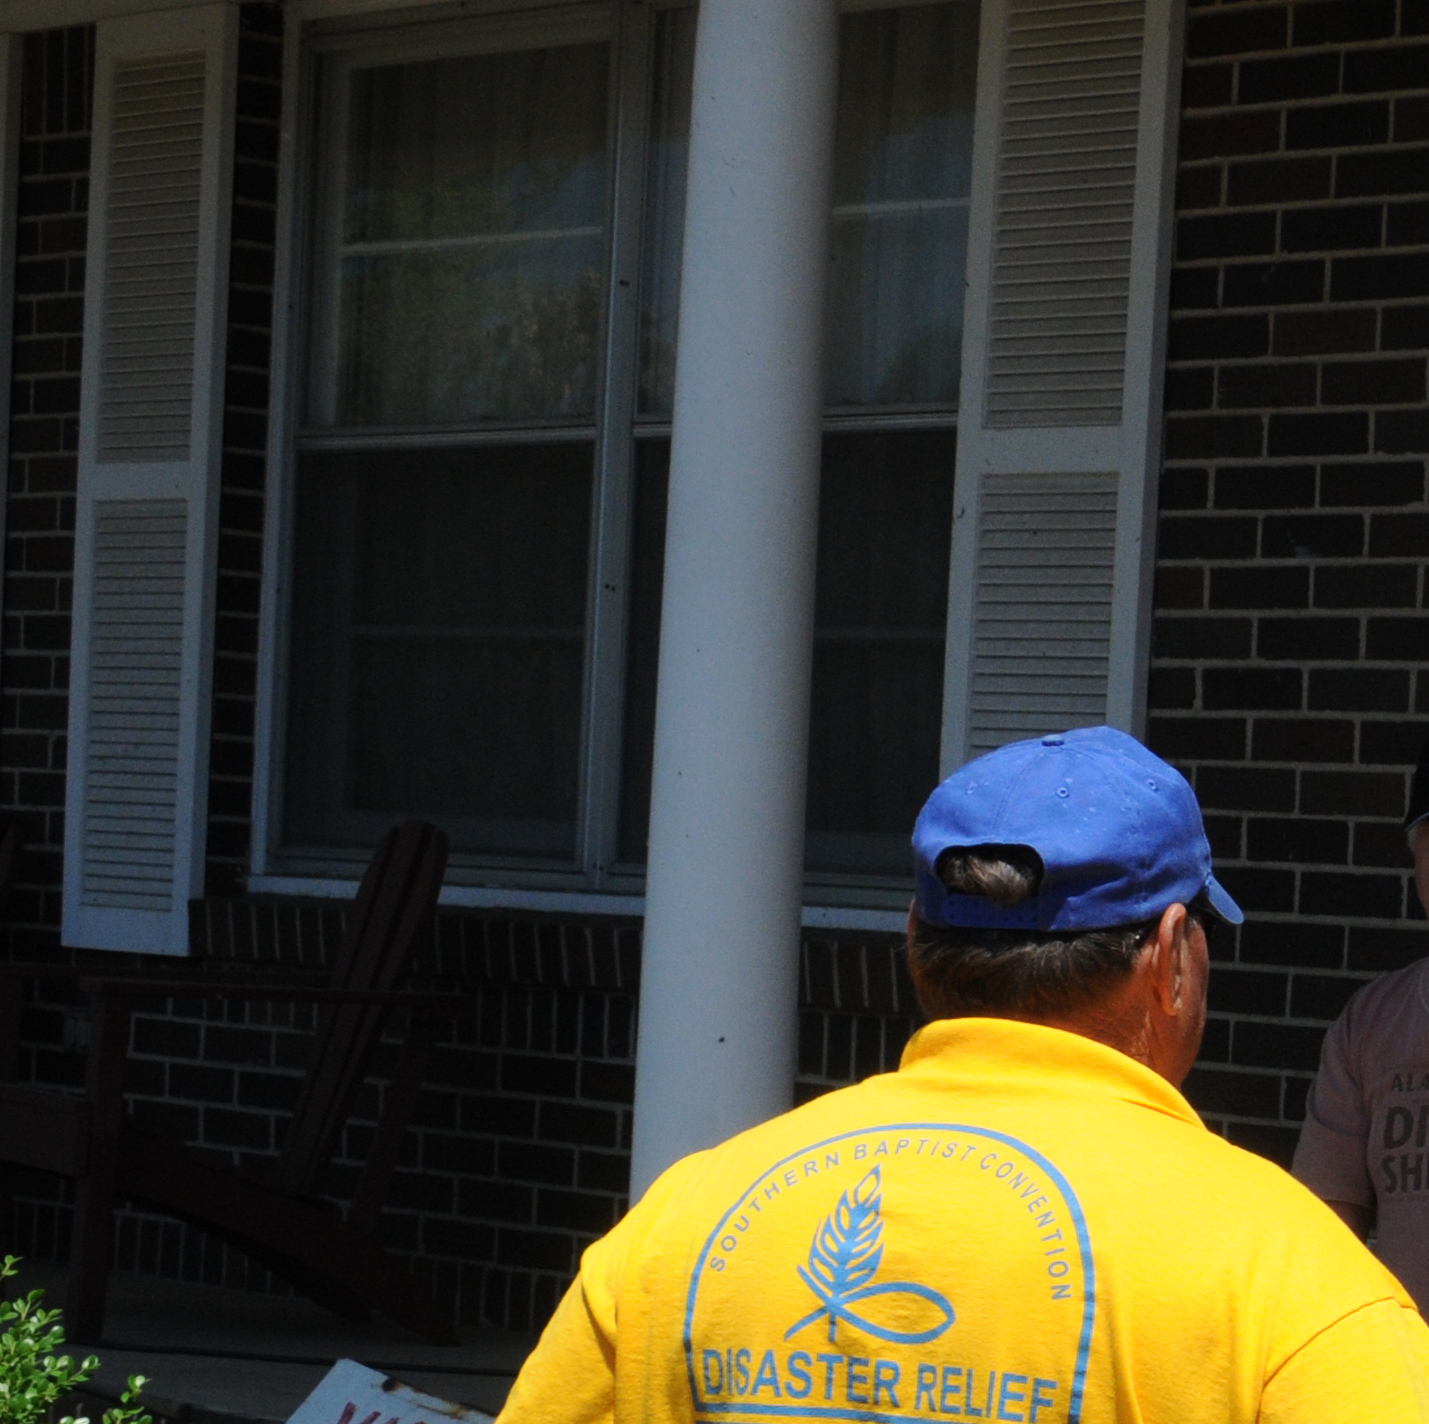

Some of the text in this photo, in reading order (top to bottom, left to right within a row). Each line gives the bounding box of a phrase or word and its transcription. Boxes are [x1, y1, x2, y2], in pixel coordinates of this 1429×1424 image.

[710, 1138, 1073, 1301] SOUTHERN BAPTIST CONVENTION
[703, 1349, 1060, 1424] DISASTER RELIEF
